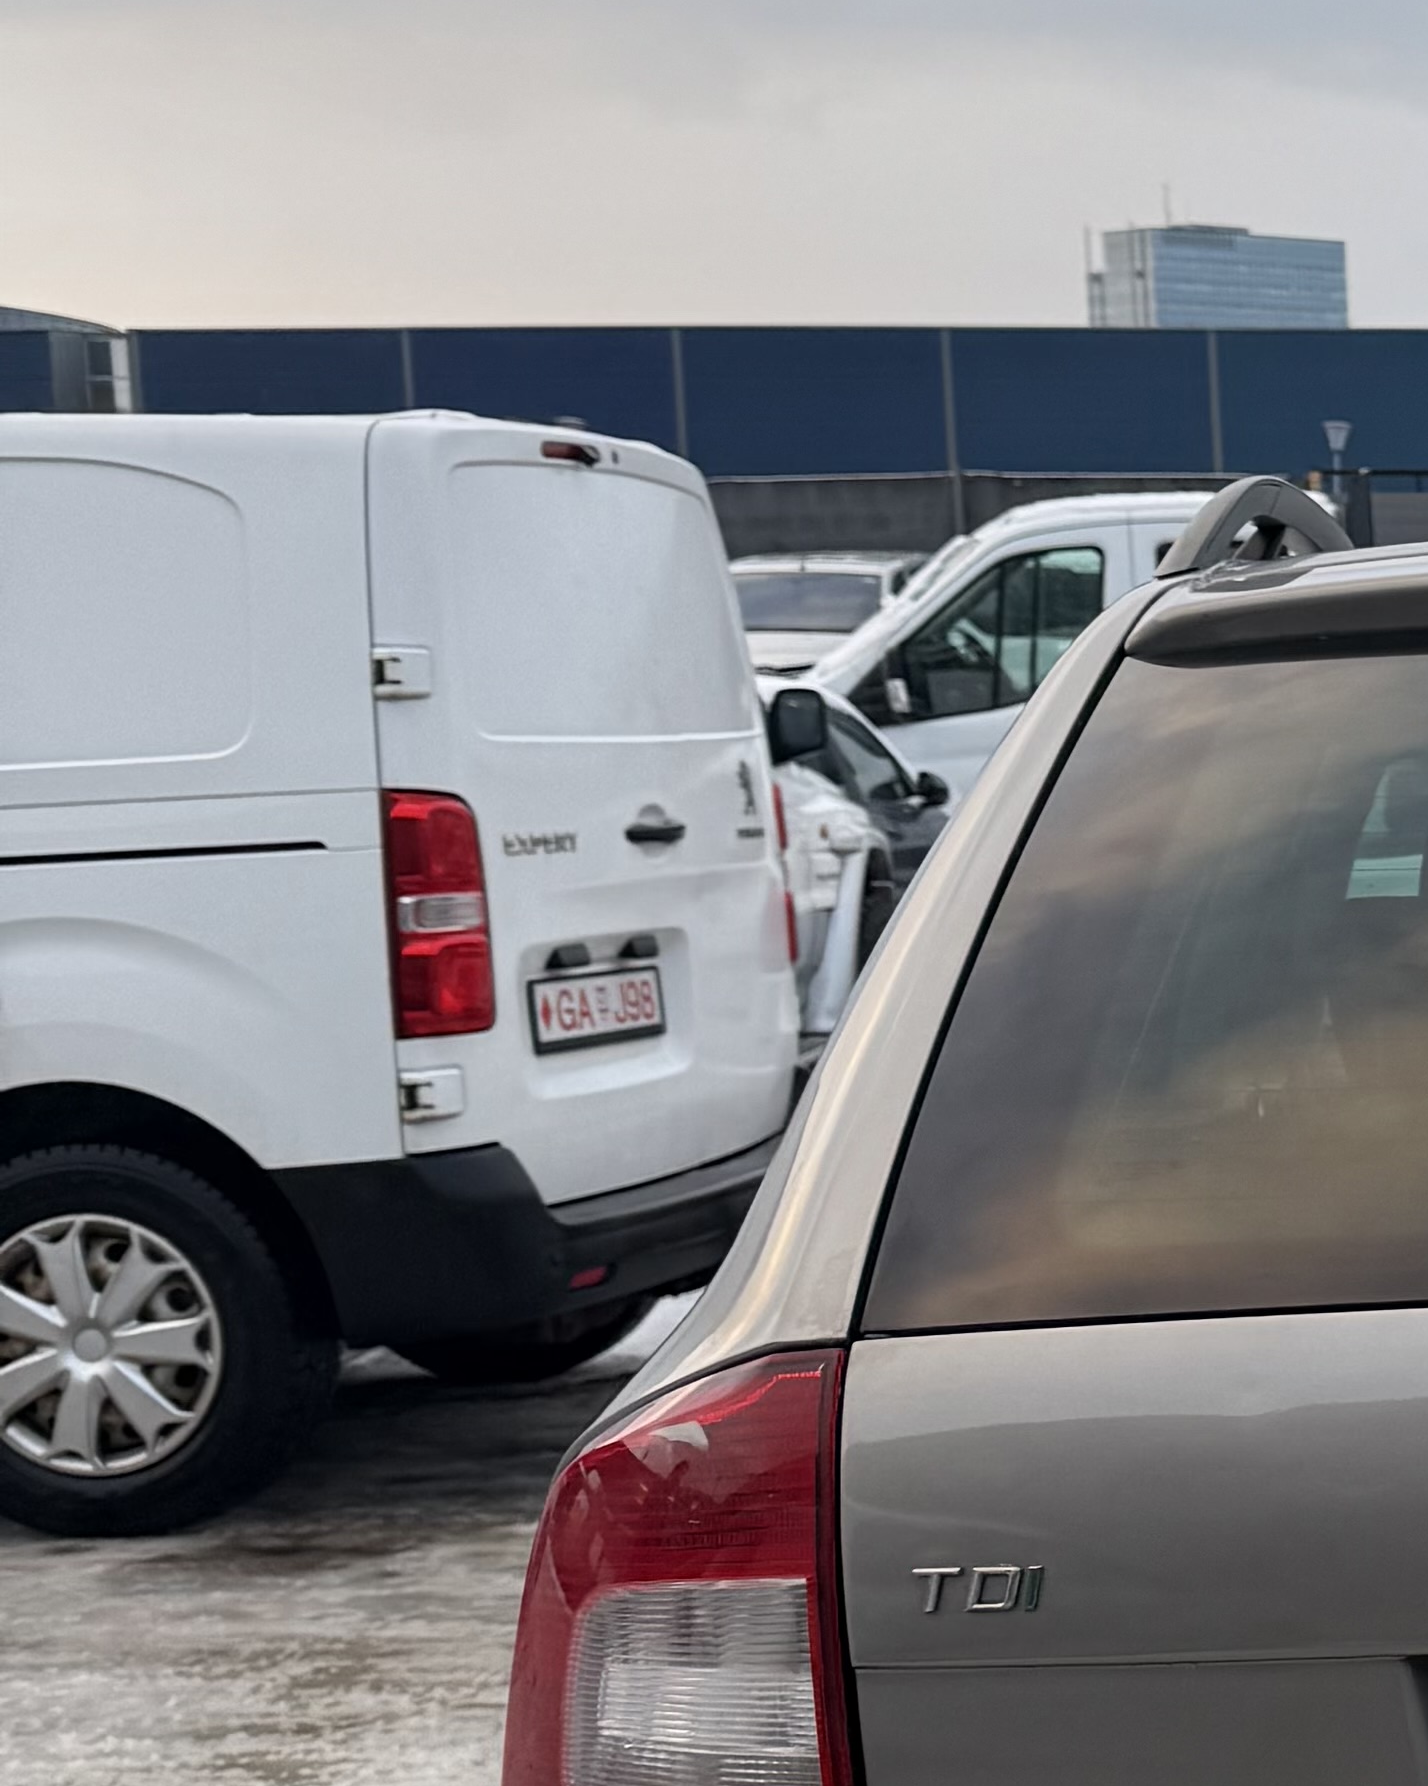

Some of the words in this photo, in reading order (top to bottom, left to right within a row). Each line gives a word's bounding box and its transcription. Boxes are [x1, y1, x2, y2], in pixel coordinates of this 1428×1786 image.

[556, 988, 597, 1031] GA
[614, 978, 655, 1024] J98
[911, 1564, 1044, 1614] TDI
